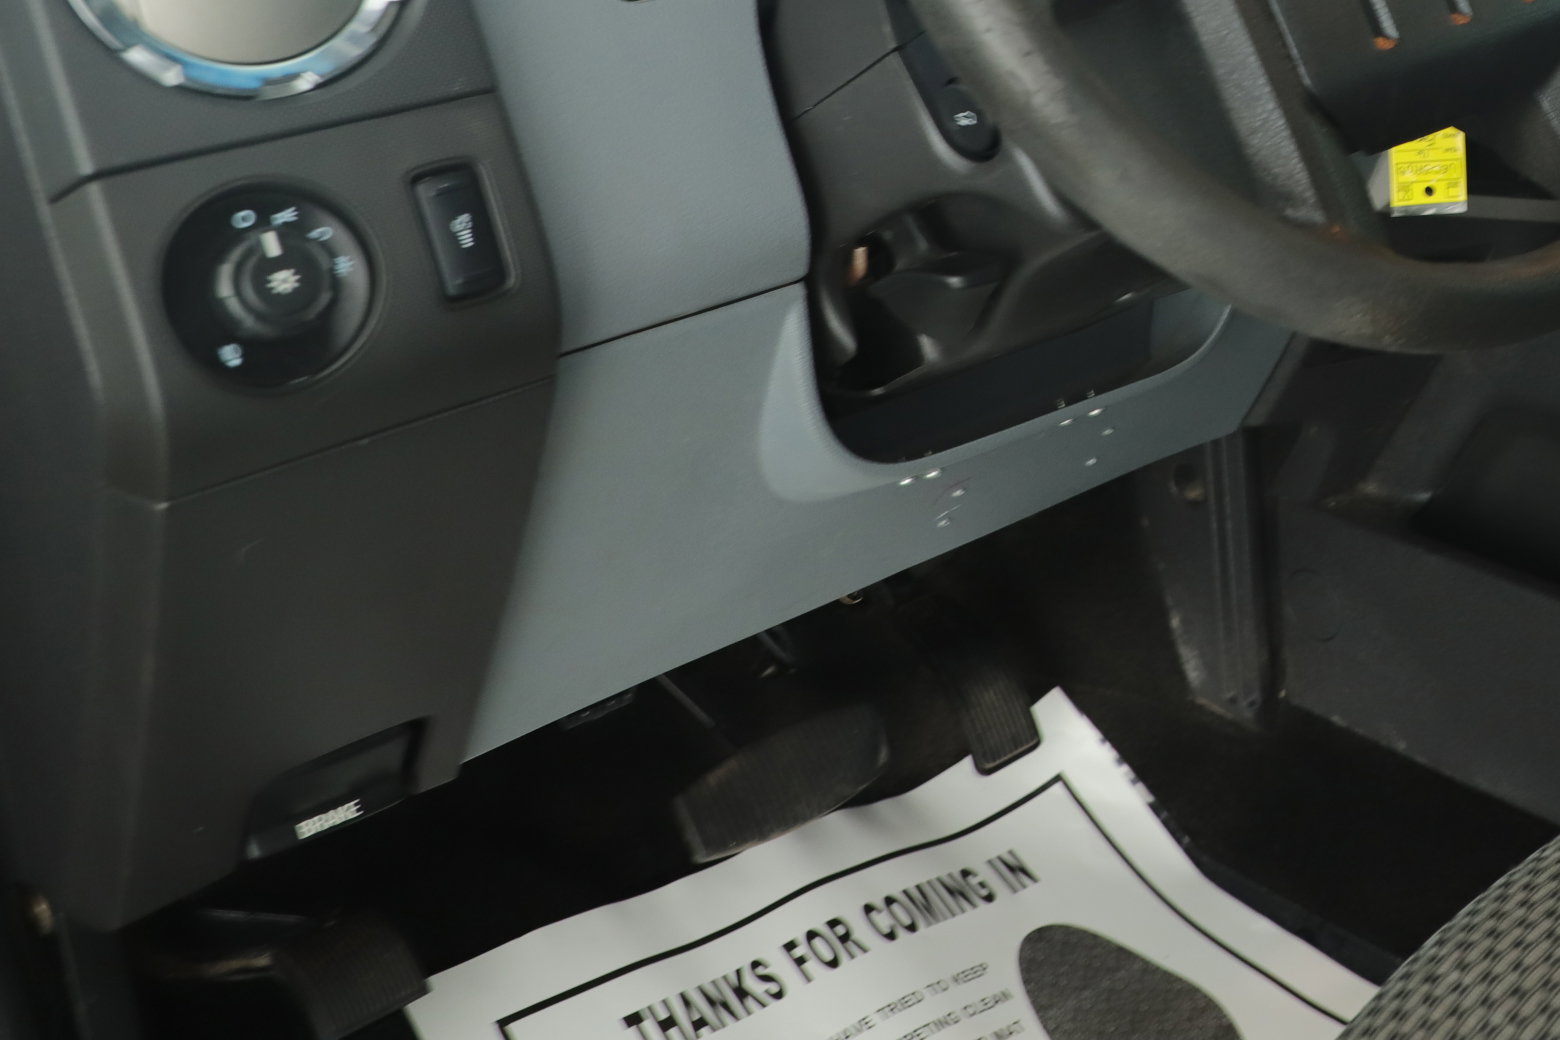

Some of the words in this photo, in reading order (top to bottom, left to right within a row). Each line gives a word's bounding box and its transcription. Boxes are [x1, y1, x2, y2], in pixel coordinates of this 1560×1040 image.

[622, 957, 789, 1040] THANKS
[782, 916, 871, 984] FOR
[862, 867, 997, 942] COMING
[985, 848, 1041, 895] IN
[875, 990, 925, 1022] TRIED
[924, 978, 950, 1006] TO
[961, 989, 1014, 1019] CLEAN
